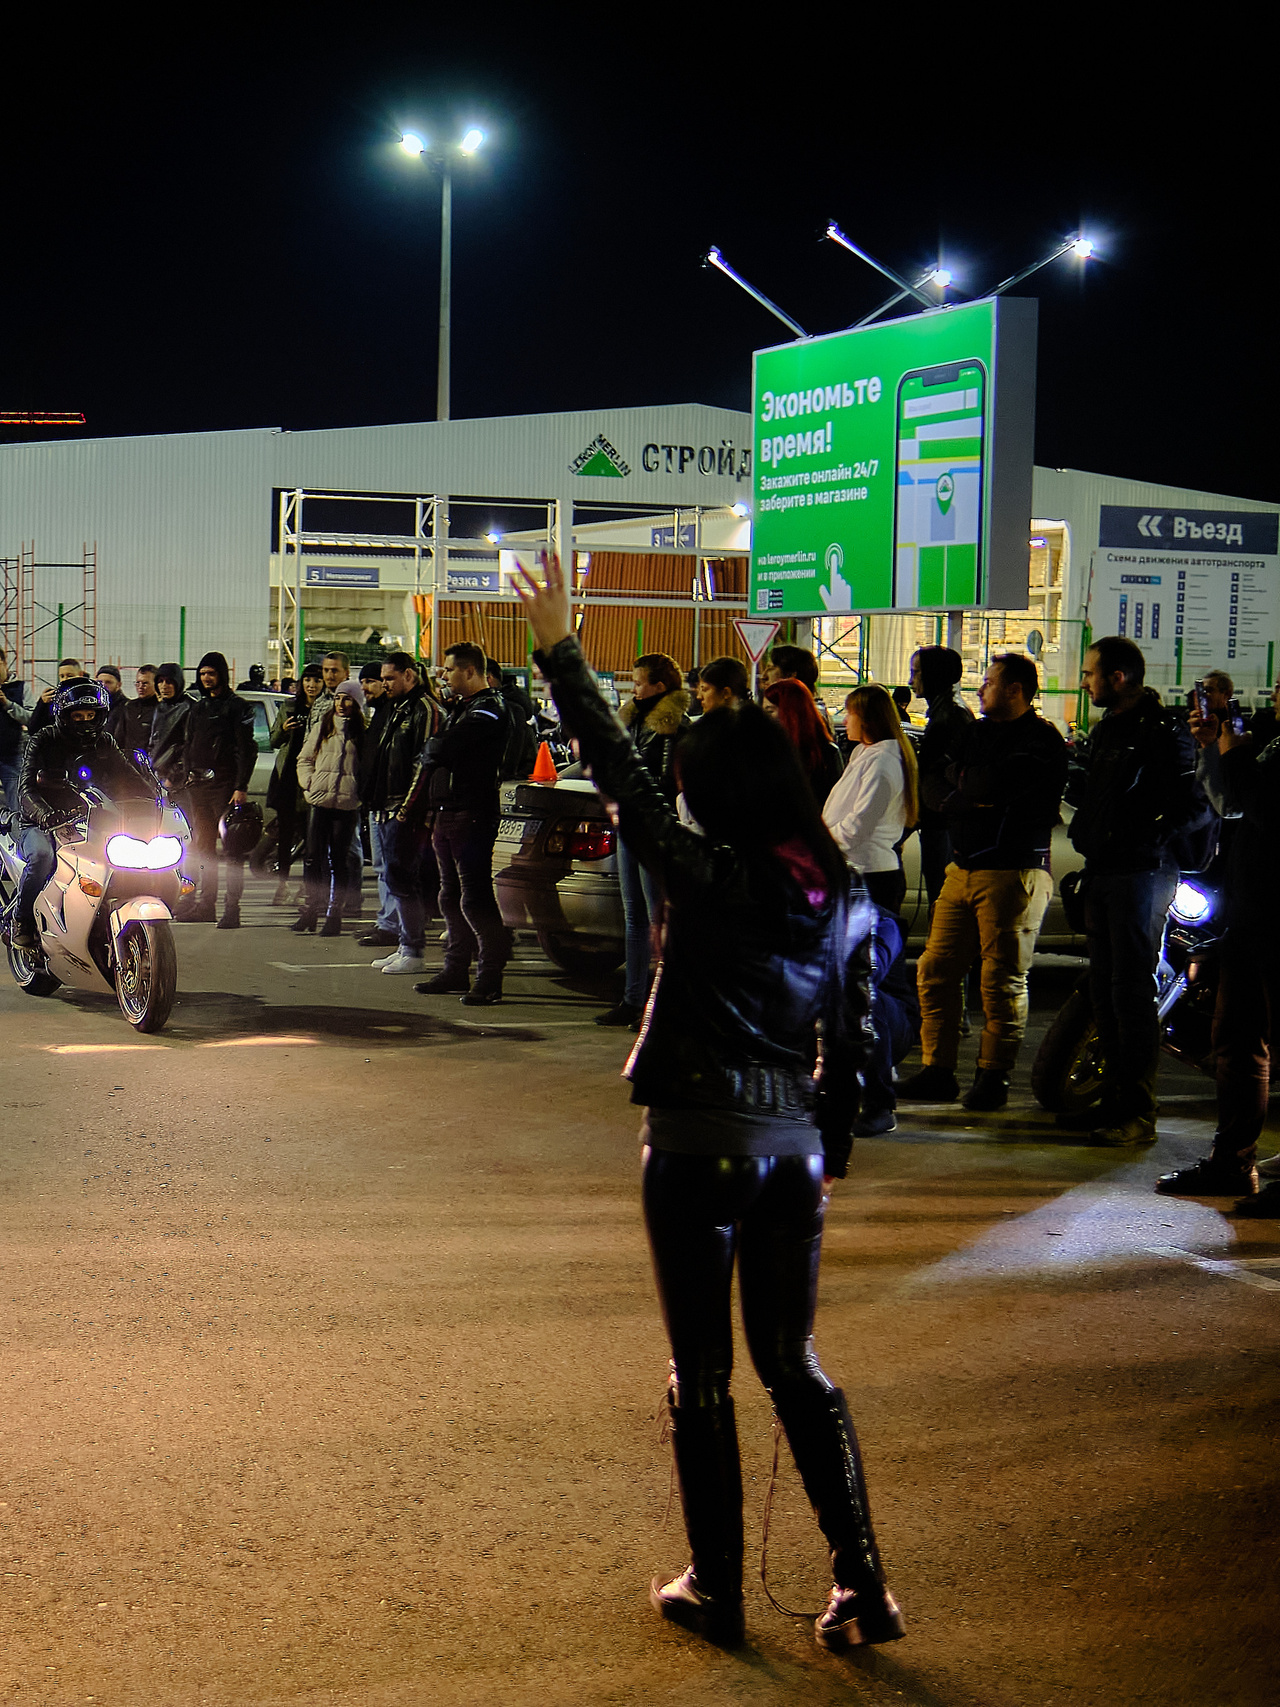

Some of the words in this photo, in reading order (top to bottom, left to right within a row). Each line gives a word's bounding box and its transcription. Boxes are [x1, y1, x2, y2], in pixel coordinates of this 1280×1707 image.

[761, 375, 882, 422] Экономьте
[568, 440, 599, 475] LEROY
[596, 433, 632, 476] MERLIN
[761, 421, 833, 468] время!
[760, 472, 810, 491] Закажите
[811, 463, 852, 484] онлайн
[853, 459, 879, 479] 24/7
[760, 493, 806, 512] заберите
[806, 493, 813, 506] в
[814, 486, 868, 505] магазине
[1173, 516, 1243, 545] Въезд
[757, 556, 766, 566] на
[767, 550, 817, 567] leroymerlin.ru
[1107, 552, 1137, 563] Схема
[1138, 555, 1189, 566] движения
[1190, 558, 1266, 570] автотранспорта
[310, 569, 320, 581] 5
[768, 568, 816, 583] приложении
